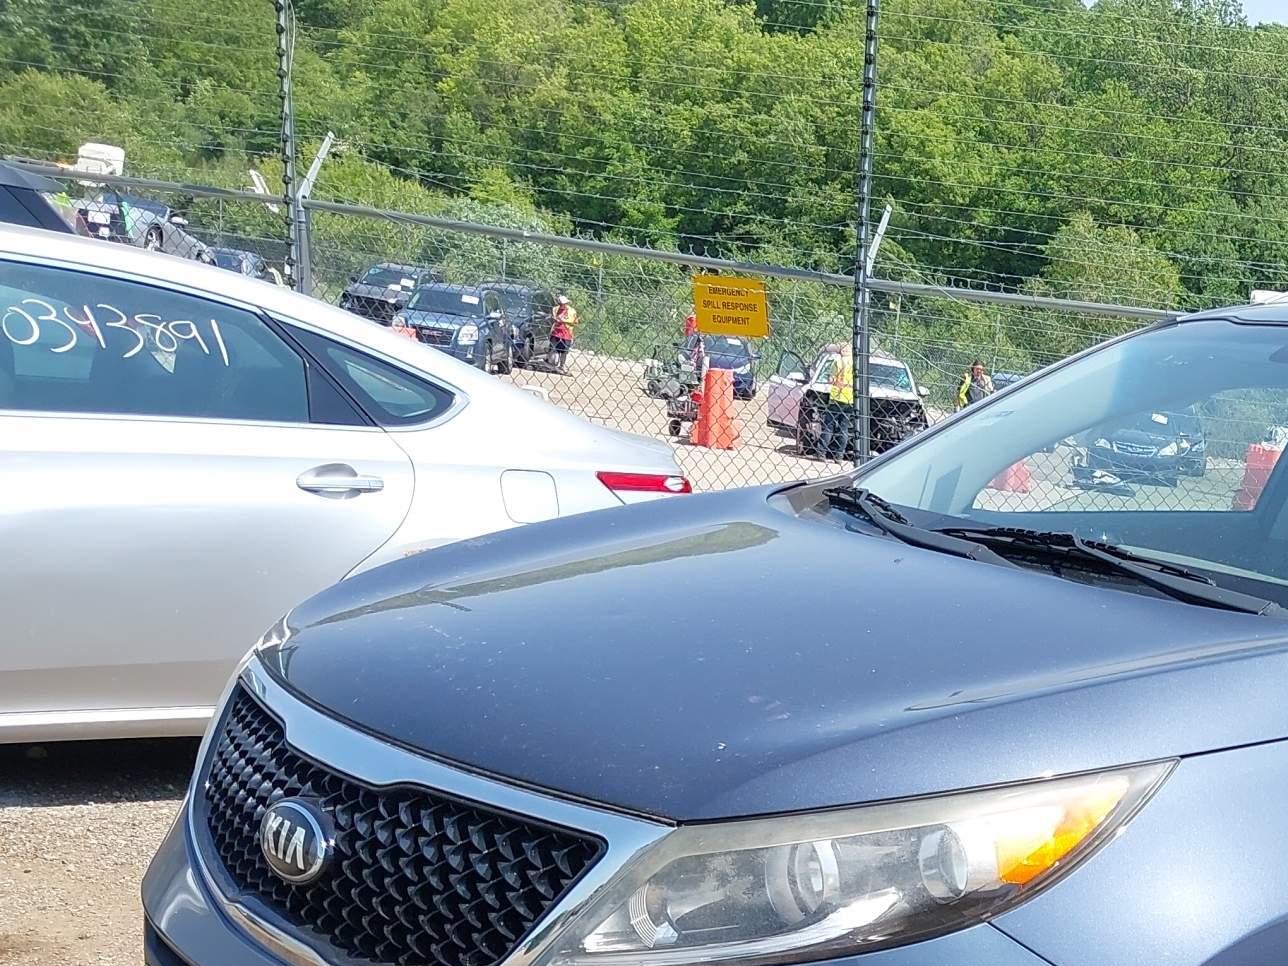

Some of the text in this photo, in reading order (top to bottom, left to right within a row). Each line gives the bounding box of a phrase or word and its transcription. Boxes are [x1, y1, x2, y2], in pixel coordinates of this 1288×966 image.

[709, 286, 749, 297] EMERGENCY
[702, 299, 758, 312] SPILL RESPONSE
[712, 314, 750, 326] EQUIPMENT
[2, 298, 230, 367] 0343891
[264, 811, 306, 870] KIA
